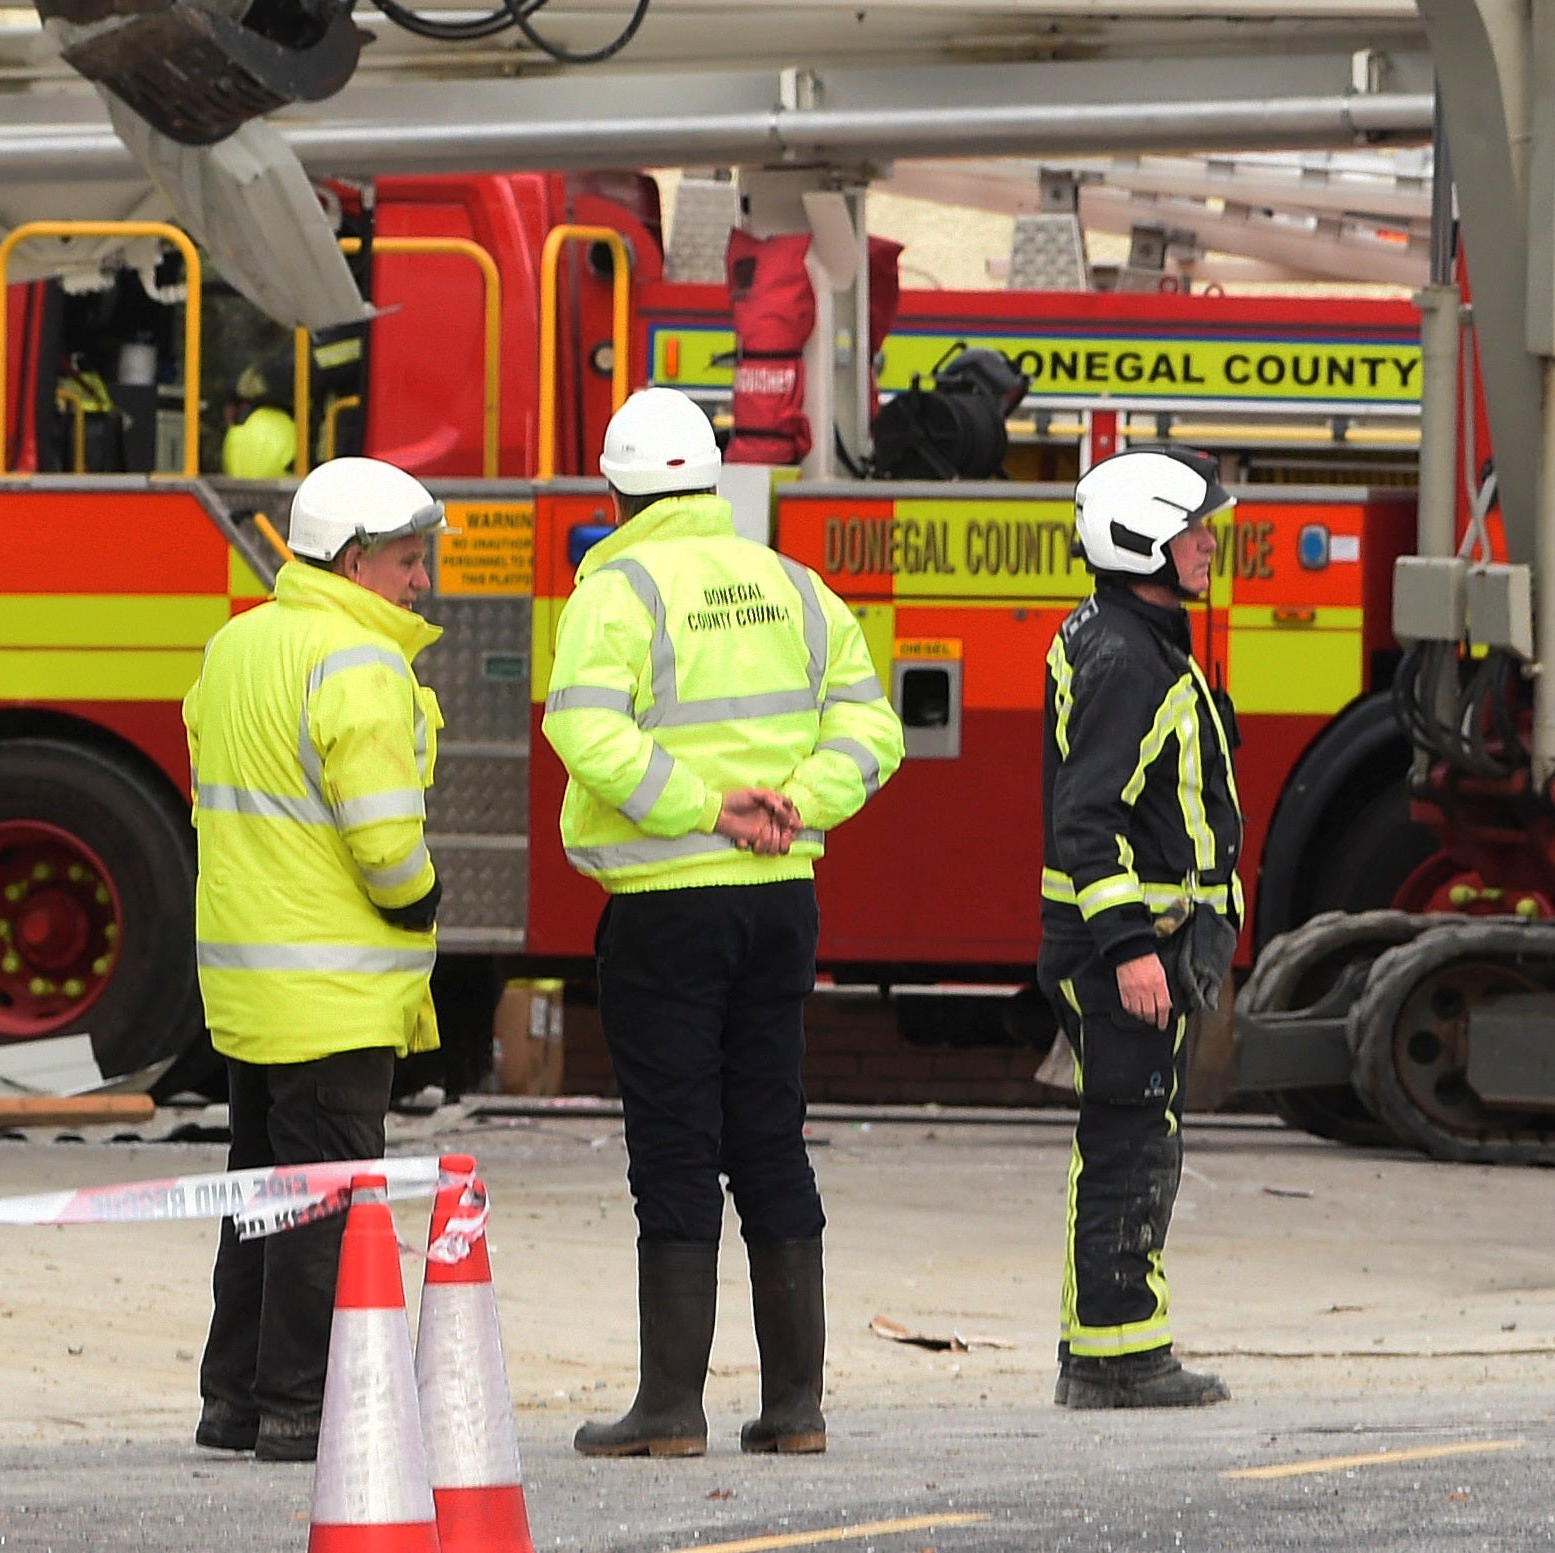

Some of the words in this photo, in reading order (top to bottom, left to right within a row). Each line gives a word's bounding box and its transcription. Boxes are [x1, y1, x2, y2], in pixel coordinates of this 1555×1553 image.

[1003, 350, 1205, 384] ONEGAL
[1223, 354, 1420, 387] COUNTY
[466, 511, 534, 528] WARNIN
[823, 518, 956, 576] DONEGAL
[966, 519, 1080, 576] COUNTY
[1210, 520, 1274, 580] VICE
[703, 582, 765, 606] DONEGAL
[687, 610, 732, 631] COUNTY
